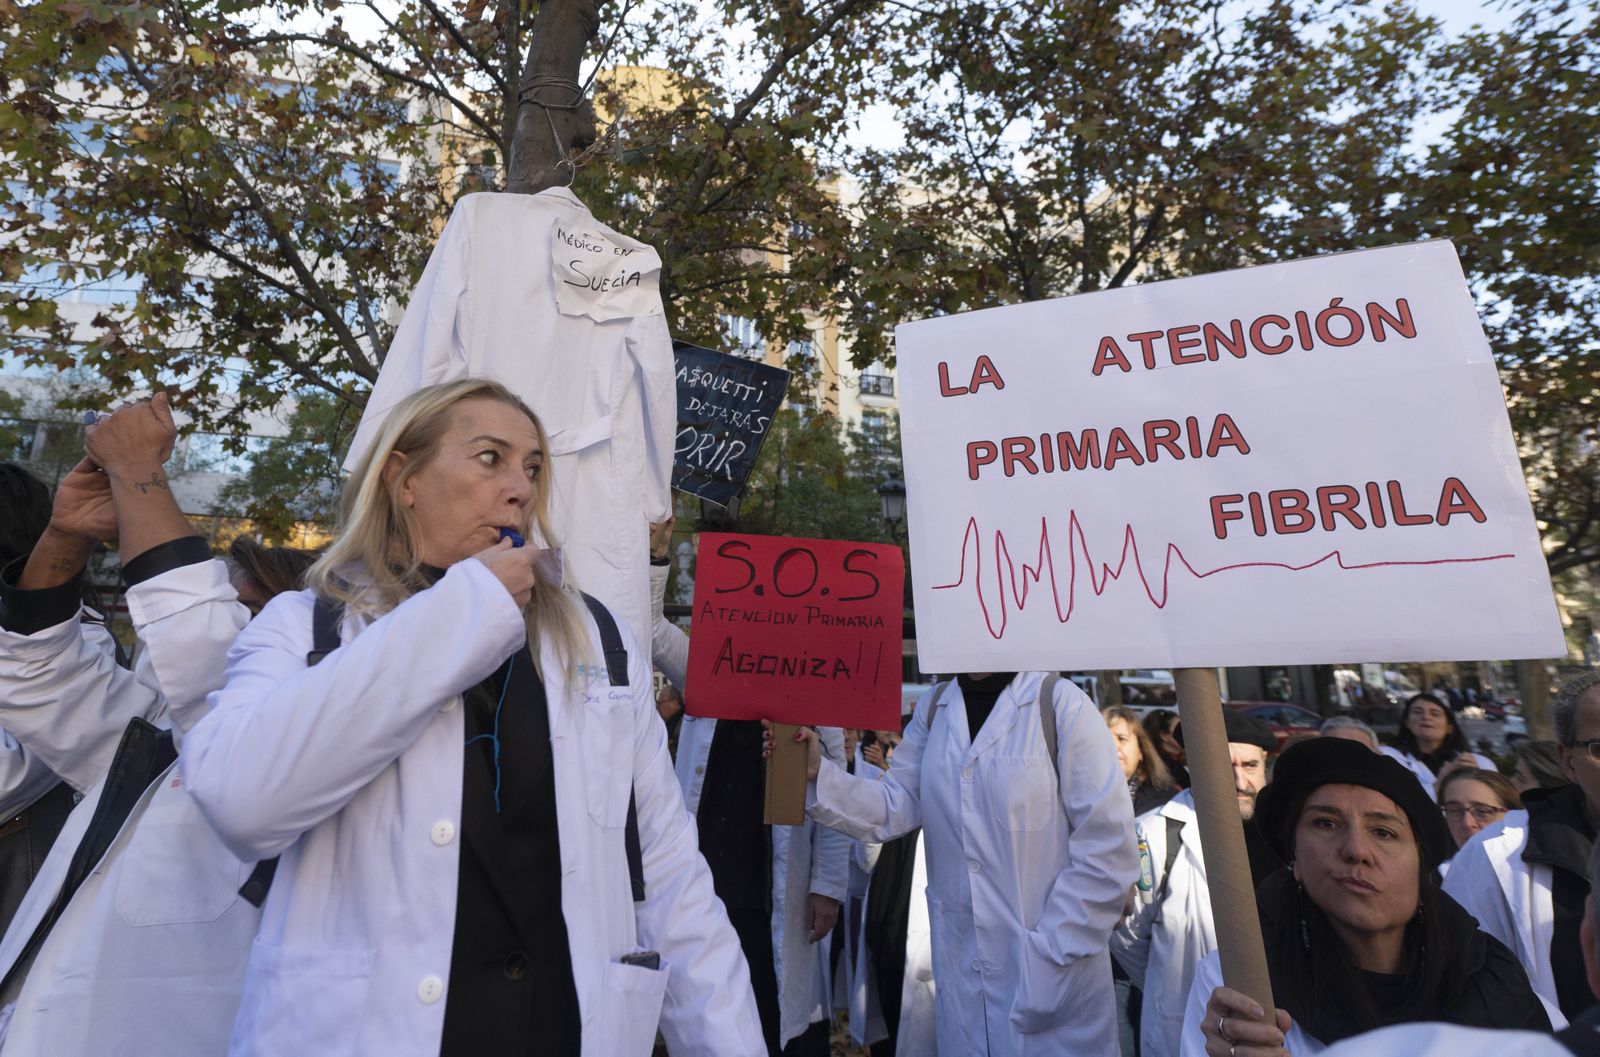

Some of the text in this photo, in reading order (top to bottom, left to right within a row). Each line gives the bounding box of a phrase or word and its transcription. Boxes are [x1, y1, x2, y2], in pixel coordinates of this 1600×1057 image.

[557, 227, 634, 257] MÉDICO EN
[563, 260, 641, 292] SUECIA
[938, 297, 1417, 397] LA ATENCIÓN
[674, 426, 747, 481] ORIR
[967, 413, 1251, 480] PRIMARIA
[1209, 476, 1487, 540] FIBRILA
[700, 600, 885, 628] ATENCION PRIMARIA
